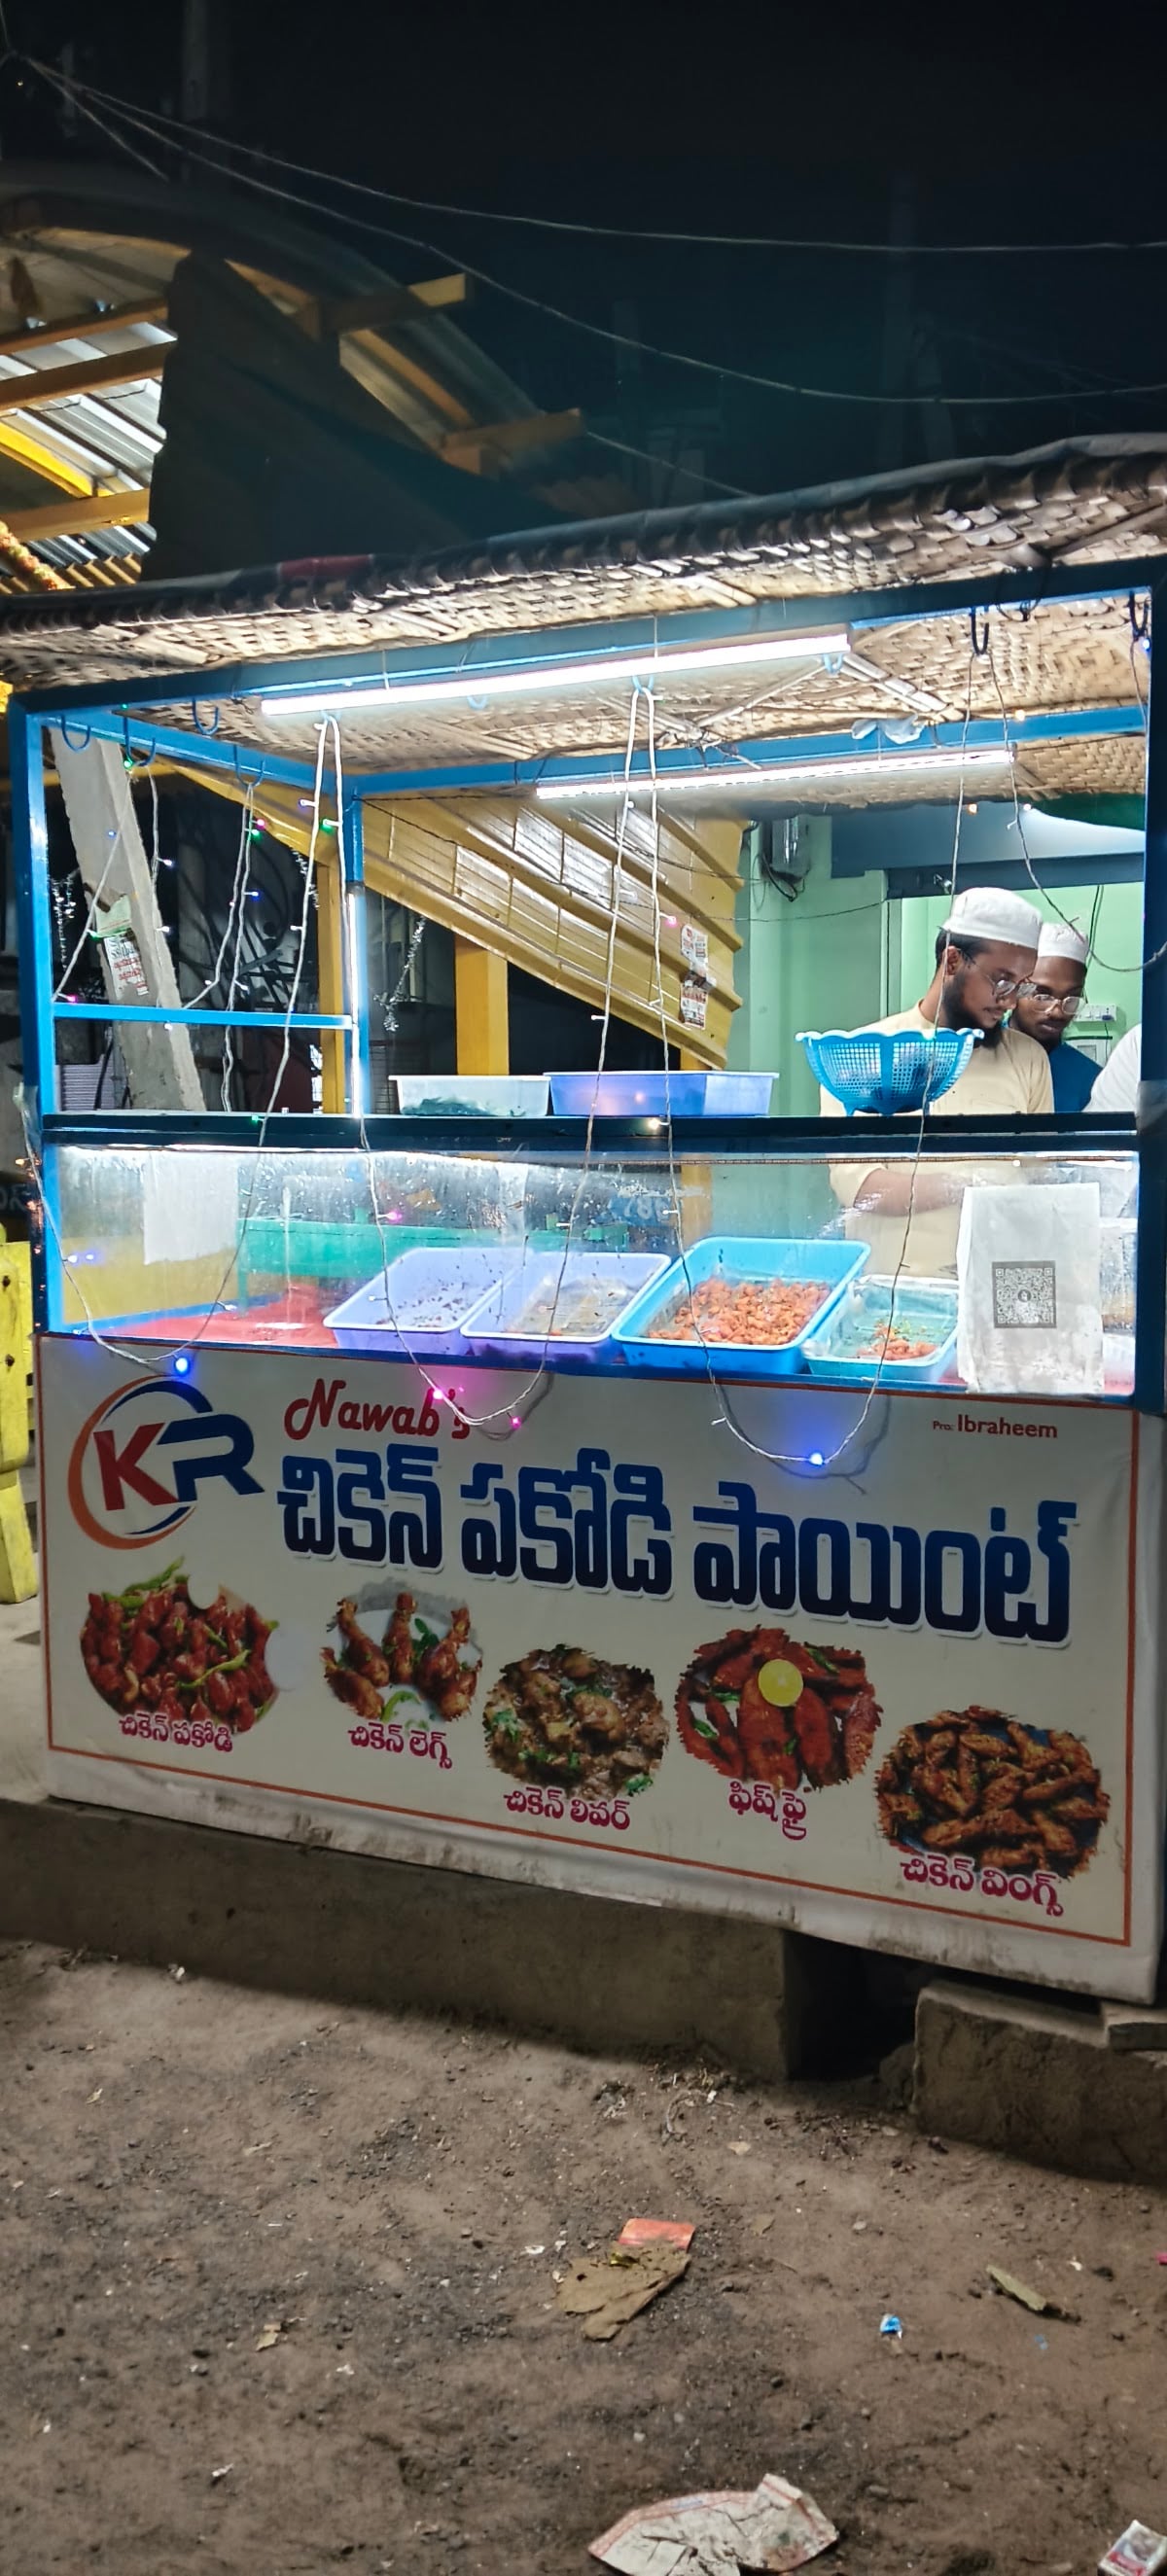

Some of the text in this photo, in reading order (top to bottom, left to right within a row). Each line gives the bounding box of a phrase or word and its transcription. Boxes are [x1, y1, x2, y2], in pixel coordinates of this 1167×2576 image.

[284, 1378, 471, 1440] Nawab's
[957, 1414, 1058, 1438] Ibraheem
[92, 1414, 265, 1511] KR
[277, 1443, 1078, 1642] చికెన్ పకోడి పాయింట్
[119, 1712, 232, 1752] చికెన్ పకోడి
[347, 1722, 453, 1769] చికెన్ లెగ్స్
[503, 1786, 630, 1830] చికెన్ లివర్
[900, 1854, 1064, 1917] చికెన్ వింగ్స్
